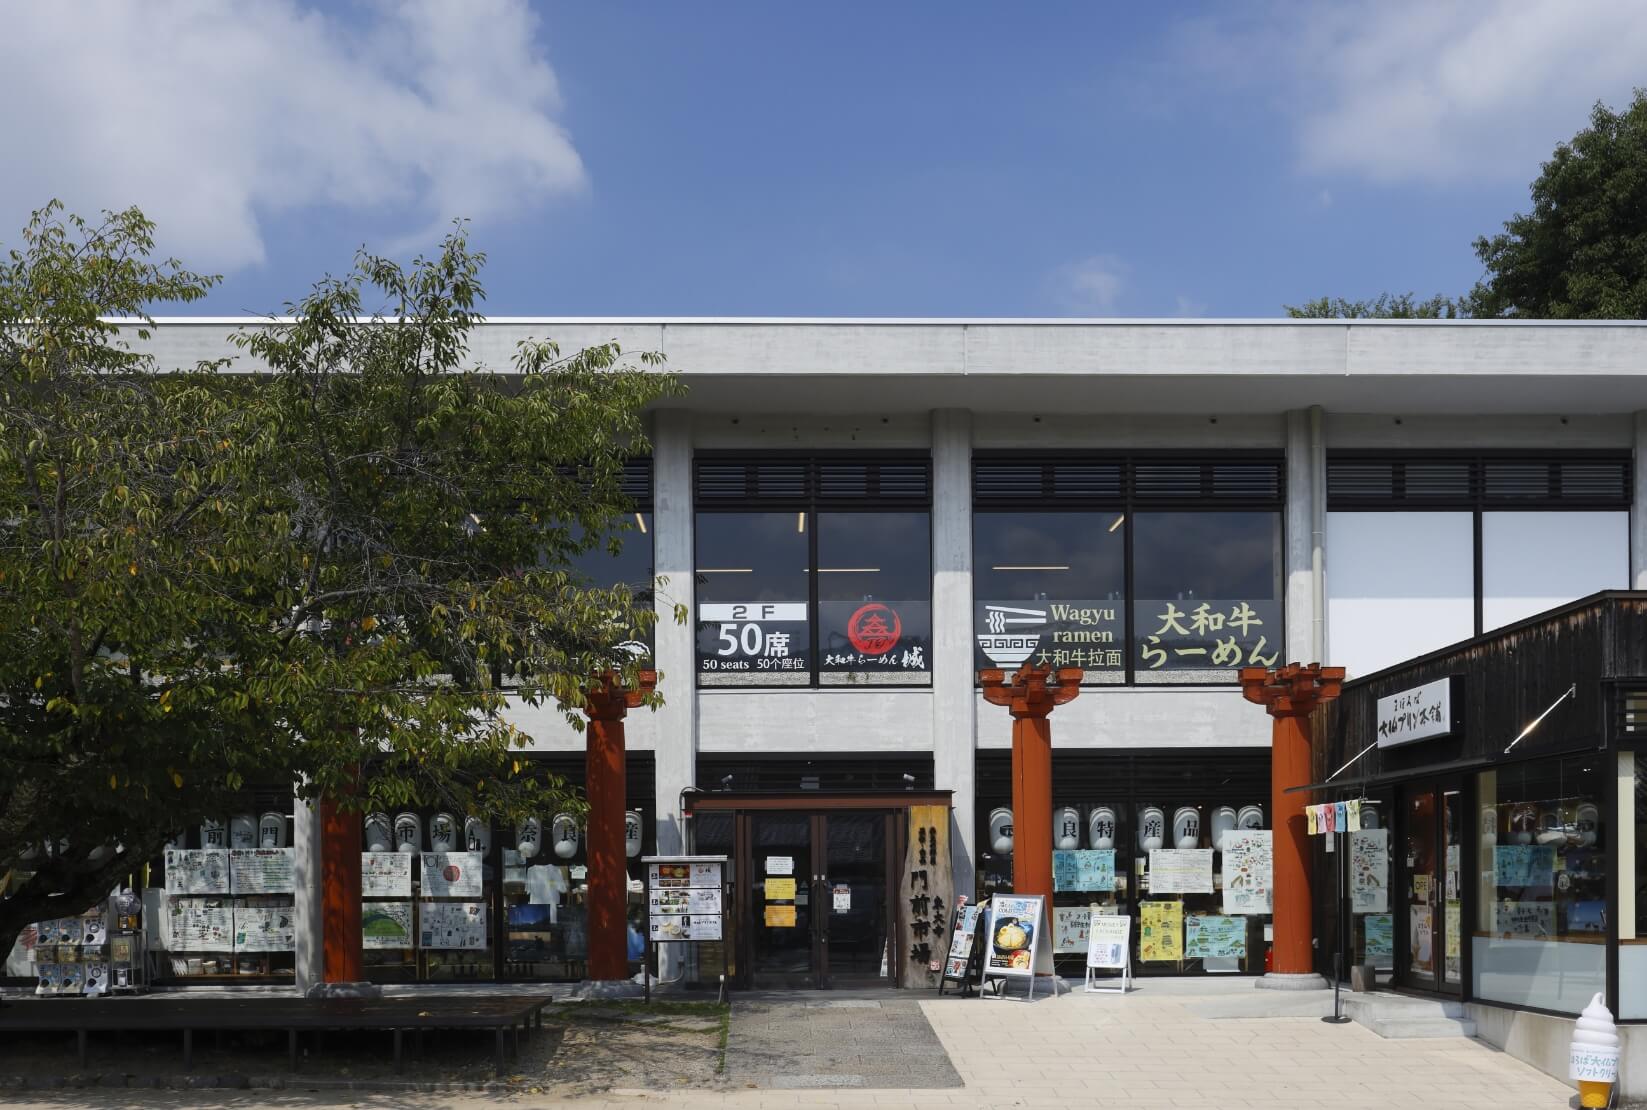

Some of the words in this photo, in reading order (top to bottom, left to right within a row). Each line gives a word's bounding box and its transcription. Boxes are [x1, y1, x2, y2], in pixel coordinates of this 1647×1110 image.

[1050, 604, 1115, 625] Wagyu
[1155, 602, 1263, 638] 大和牛
[718, 623, 790, 657] 50席
[1053, 629, 1113, 643] ramen
[1035, 649, 1122, 667] 大和牛拉面
[1141, 635, 1279, 668] らーめん
[703, 659, 718, 670] 50
[721, 660, 750, 670] seats
[757, 658, 805, 670] 50个座位
[909, 870, 931, 965] 門前市場
